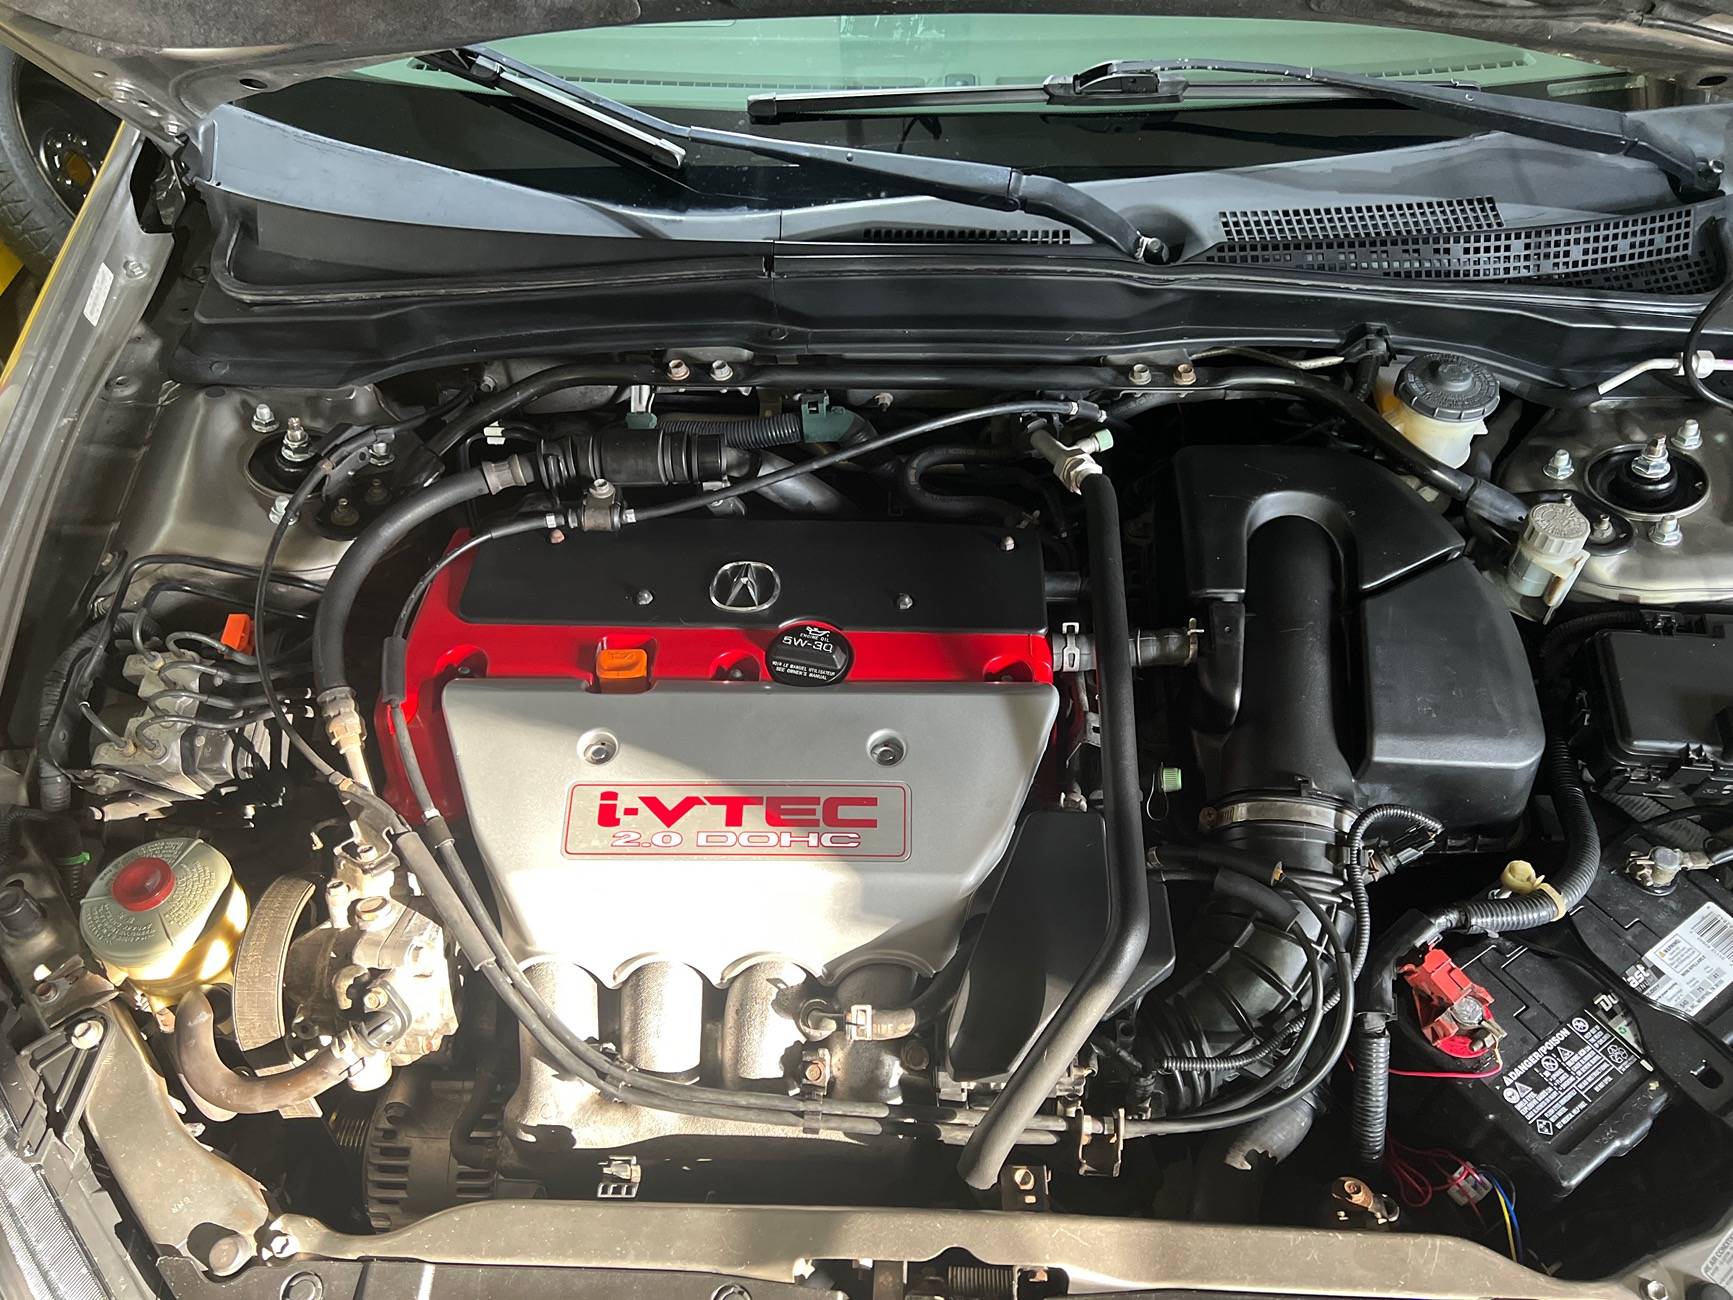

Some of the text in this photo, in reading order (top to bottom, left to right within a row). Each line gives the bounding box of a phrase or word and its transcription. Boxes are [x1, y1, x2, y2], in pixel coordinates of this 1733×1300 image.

[782, 636, 833, 653] 5W-30
[786, 668, 808, 676] OWNER'S
[809, 672, 827, 680] MANUAL
[808, 668, 835, 676] UTILISATEUR
[597, 791, 878, 828] i-VTEC
[611, 831, 860, 848] 2.0 DOHC
[1508, 1028, 1571, 1081] DANGER/POISON
